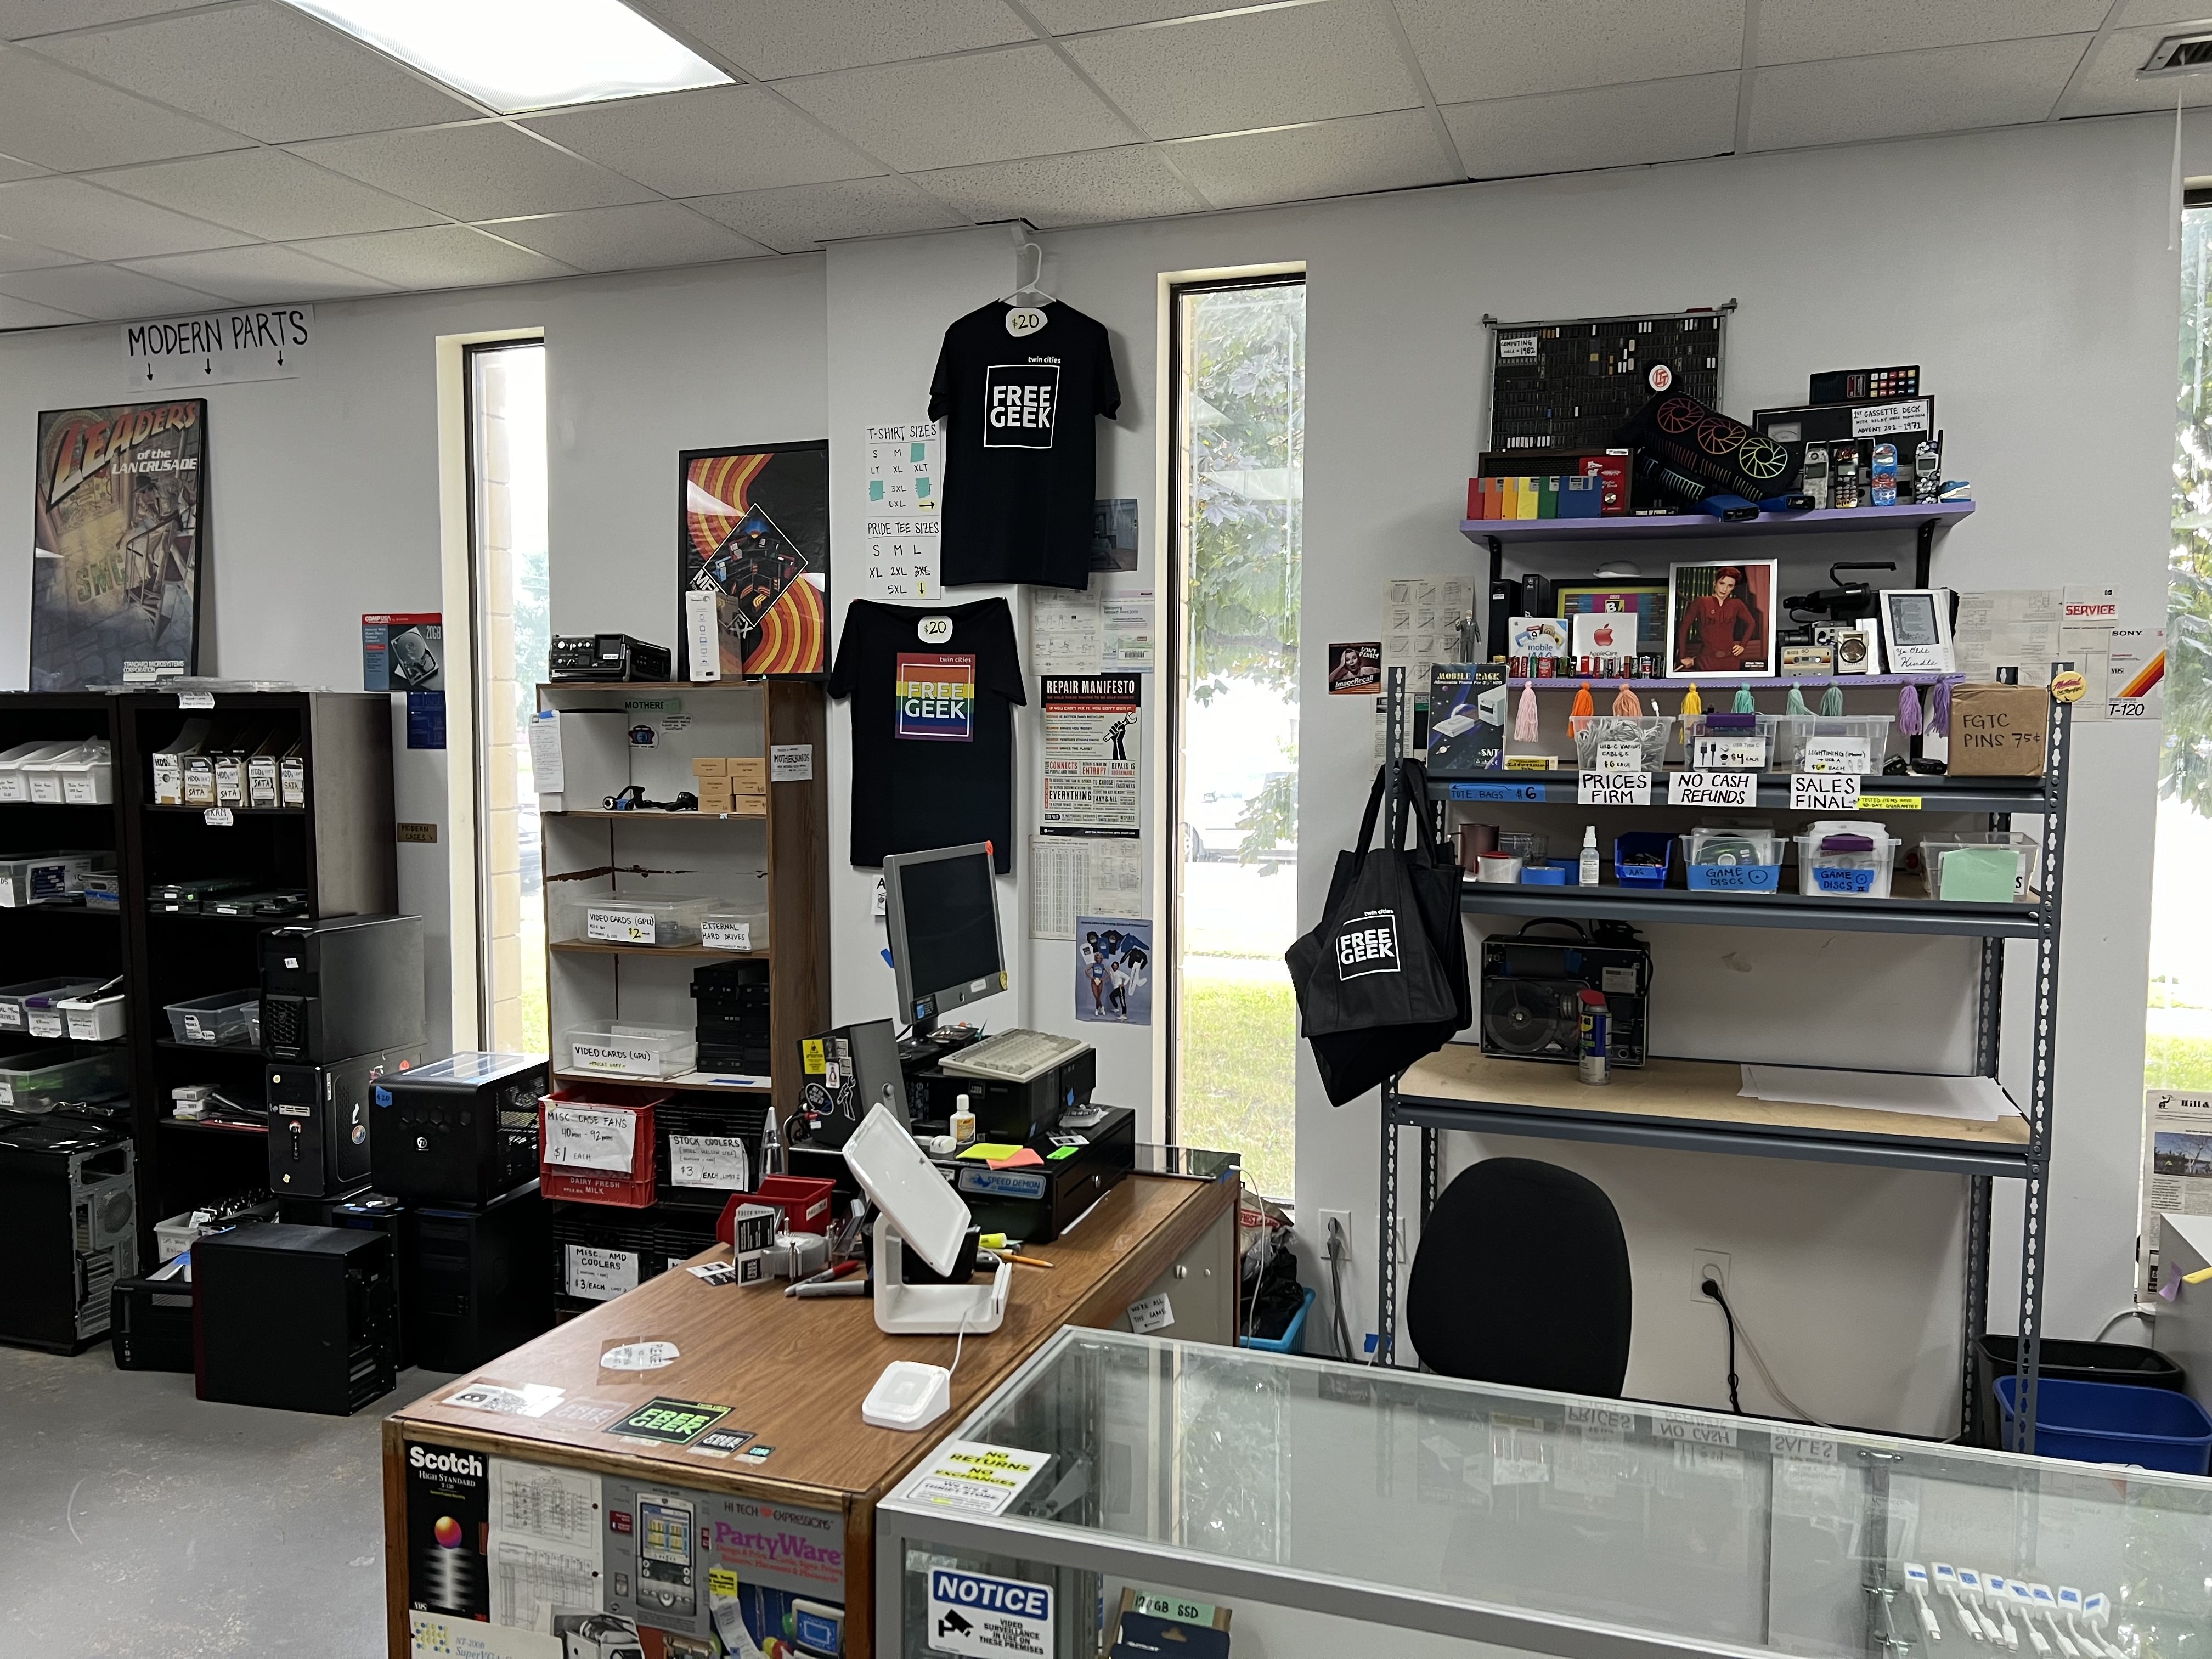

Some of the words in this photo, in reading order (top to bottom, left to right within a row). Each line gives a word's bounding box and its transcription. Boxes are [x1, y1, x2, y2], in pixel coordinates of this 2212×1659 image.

[1012, 314, 1039, 329] $20
[128, 319, 222, 356] MODERN
[232, 311, 308, 350] PARTS
[993, 386, 1051, 407] FREE
[990, 407, 1051, 428] GEEK
[1864, 408, 1898, 417] CASSETTE
[867, 427, 905, 441] T-SHIRT
[910, 425, 936, 437] SIZES
[46, 403, 196, 510] LEADERS
[137, 449, 150, 460] of
[151, 449, 170, 459] the
[112, 461, 138, 474] LAN
[139, 459, 198, 472] CRUSADE
[914, 464, 927, 472] XLT
[868, 523, 891, 535] PRIDE
[895, 523, 911, 533] TEE
[915, 522, 939, 534] SIZES
[873, 544, 880, 556] S
[894, 545, 902, 555] M
[914, 545, 921, 554] L
[75, 553, 127, 604] SMC
[869, 567, 883, 578] XL
[890, 567, 907, 575] 2XL
[888, 585, 907, 594] 5XL
[2065, 605, 2115, 616] SERVICE
[426, 625, 441, 640] 20GB
[923, 621, 946, 634] $20
[1910, 646, 1930, 654] Olde
[1901, 657, 1938, 667] Kindle
[1047, 680, 1079, 693] REPAIR
[1082, 680, 1135, 693] MANIFESTO
[1335, 674, 1374, 689] ImageRecall
[907, 681, 964, 700] FREE
[905, 699, 966, 719] GEEK
[2108, 703, 2145, 716] T-120
[1963, 713, 2010, 729] FGTC
[1963, 734, 2005, 748] PINS
[2011, 733, 2041, 748] 75¢
[774, 754, 810, 764] MOTHERBOARDS
[1731, 753, 1744, 764] $4
[254, 779, 270, 787] SATA
[1583, 774, 1647, 789] PRICES
[1678, 775, 1703, 787] NO
[1712, 775, 1749, 788] CASH
[1796, 777, 1855, 794] SALES
[1049, 791, 1092, 800] EVERYTHING
[1451, 789, 1471, 799] TOTE
[1479, 790, 1503, 799] BAGS
[1516, 786, 1536, 800] $6
[1592, 789, 1634, 803] FIRM
[1681, 789, 1746, 804] REFUNDS
[1796, 794, 1853, 809] FINAL
[1706, 868, 1743, 878] GAME
[1821, 871, 1852, 880] GAME
[1710, 878, 1744, 886] DISCS
[1824, 881, 1852, 890] DISCS
[590, 913, 608, 923] VIDEO
[610, 915, 631, 924] CARDS
[635, 916, 654, 926] (GPU)
[702, 922, 738, 930] EXTERNAL
[629, 928, 641, 940] $2
[1340, 928, 1392, 951] FREE
[1341, 943, 1395, 964] GEEK
[575, 1046, 600, 1058] VIDEO
[602, 1049, 627, 1059] CARDS
[630, 1050, 651, 1062] (GPU)
[578, 1115, 599, 1125] CASE
[604, 1117, 627, 1128] FANS
[562, 1128, 582, 1138] 40mm
[590, 1130, 613, 1141] 92mm
[674, 1136, 700, 1146] STOCK
[705, 1139, 740, 1148] COOLERS
[554, 1146, 566, 1161] $1
[574, 1153, 591, 1162] EACH
[681, 1166, 693, 1176] $3
[595, 1180, 620, 1188] FRESH
[988, 1176, 1011, 1186] SPEED
[1014, 1179, 1041, 1189] DEMON
[609, 1253, 627, 1261] AMD
[582, 1257, 621, 1271] COOLERS
[1153, 1297, 1164, 1306] ALL
[1149, 1308, 1167, 1318] SAME
[641, 1408, 710, 1428] FREE
[629, 1417, 701, 1435] GEEK
[410, 1446, 482, 1477] Scotch
[950, 1453, 1031, 1471] RETURNS
[419, 1470, 437, 1481] HIGH
[439, 1473, 476, 1487] STANDARD
[935, 1469, 1017, 1487] EXCHANGES
[724, 1502, 734, 1511] HI
[736, 1503, 758, 1516] TECH
[715, 1521, 842, 1566] PartyWare
[937, 1575, 1044, 1615] NOTICE
[414, 1601, 427, 1611] VHS
[1177, 1604, 1199, 1619] SSD
[1000, 1618, 1023, 1629] VIDEO
[984, 1622, 1040, 1640] SURVEILLANCE
[1003, 1632, 1018, 1641] USE
[1019, 1635, 1030, 1644] ON
[979, 1635, 1003, 1647] THESE
[1005, 1641, 1044, 1655] PREMISES
